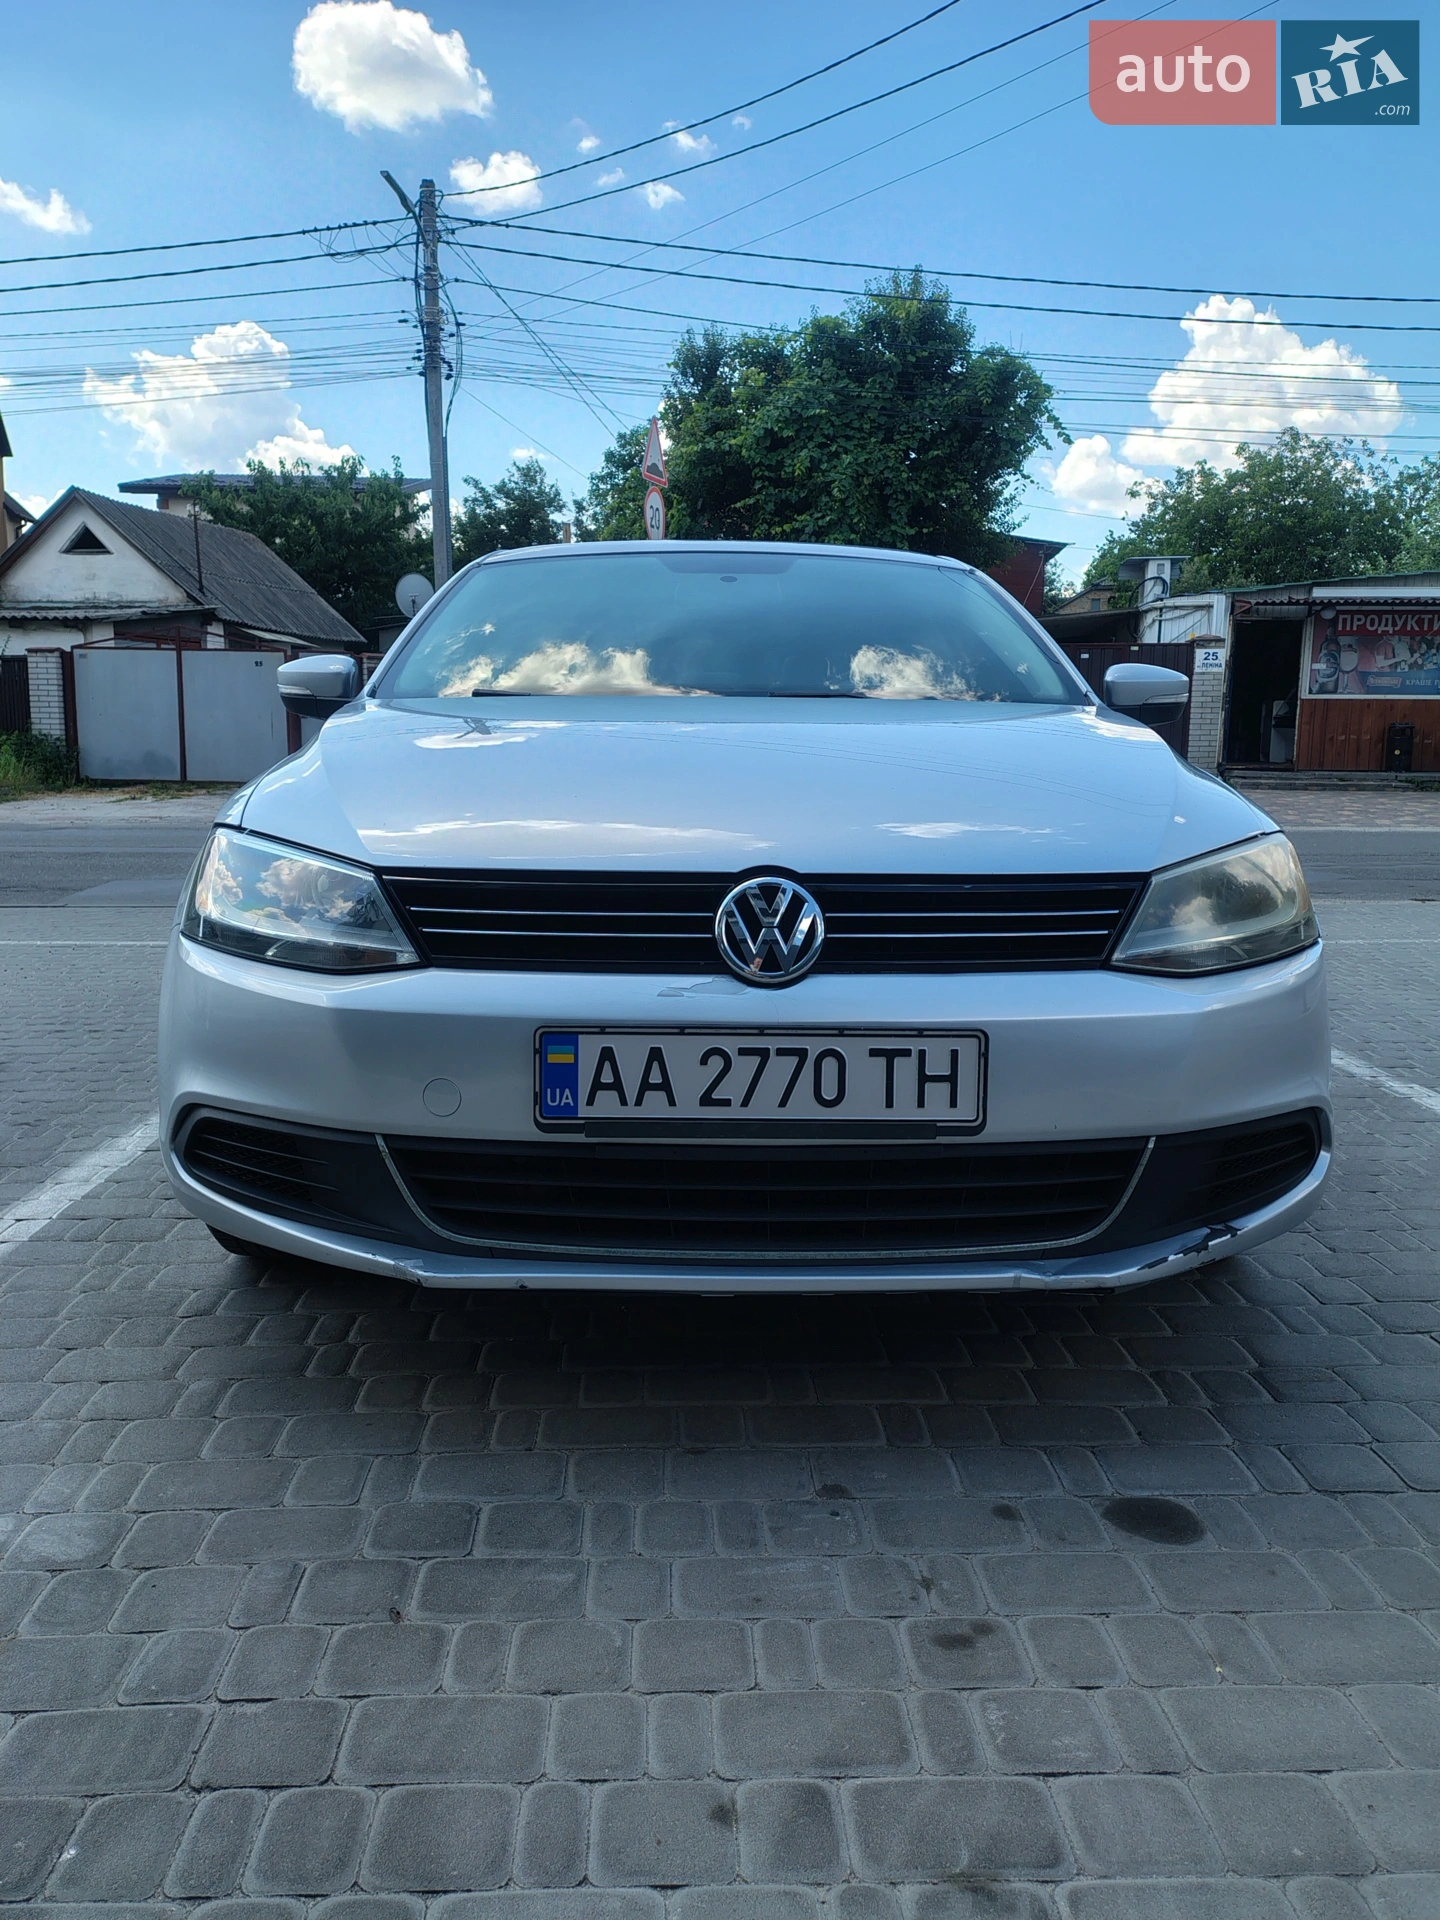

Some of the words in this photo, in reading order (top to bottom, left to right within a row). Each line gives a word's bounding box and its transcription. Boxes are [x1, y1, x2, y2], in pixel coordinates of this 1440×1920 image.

[649, 504, 660, 530] 20
[1337, 614, 1440, 634] ПРОДУКТИ
[1203, 651, 1219, 661] 25
[585, 1045, 677, 1107] AA
[698, 1046, 847, 1108] 2770
[868, 1047, 959, 1109] TH
[546, 1087, 574, 1107] UA
